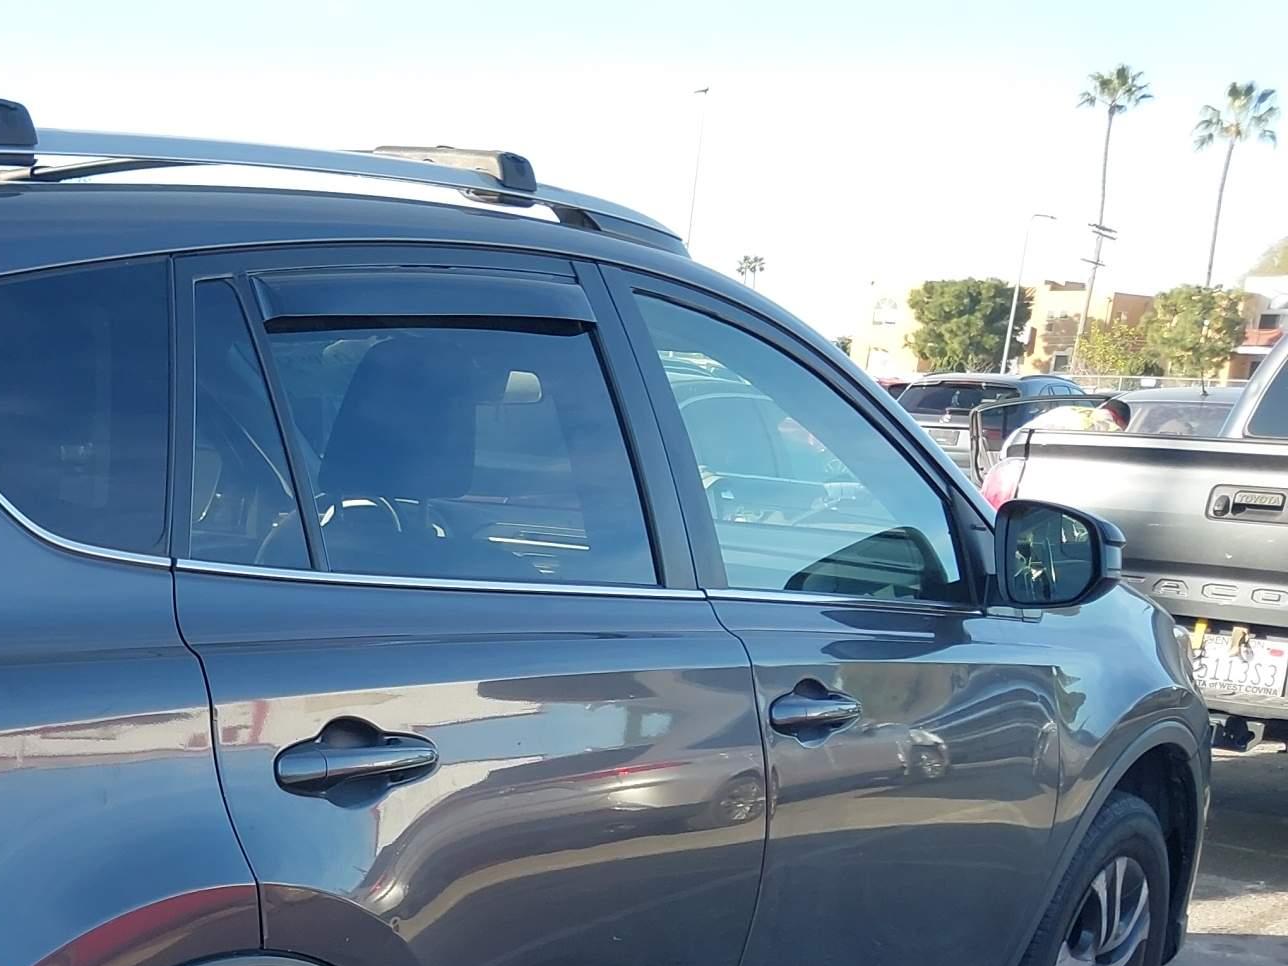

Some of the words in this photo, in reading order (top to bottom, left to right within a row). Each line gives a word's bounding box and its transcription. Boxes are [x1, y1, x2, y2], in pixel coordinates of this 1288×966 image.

[1238, 494, 1281, 504] TOYOTA
[1122, 574, 1288, 606] ACO
[1219, 682, 1244, 692] WEST
[1245, 685, 1278, 696] COVINA
